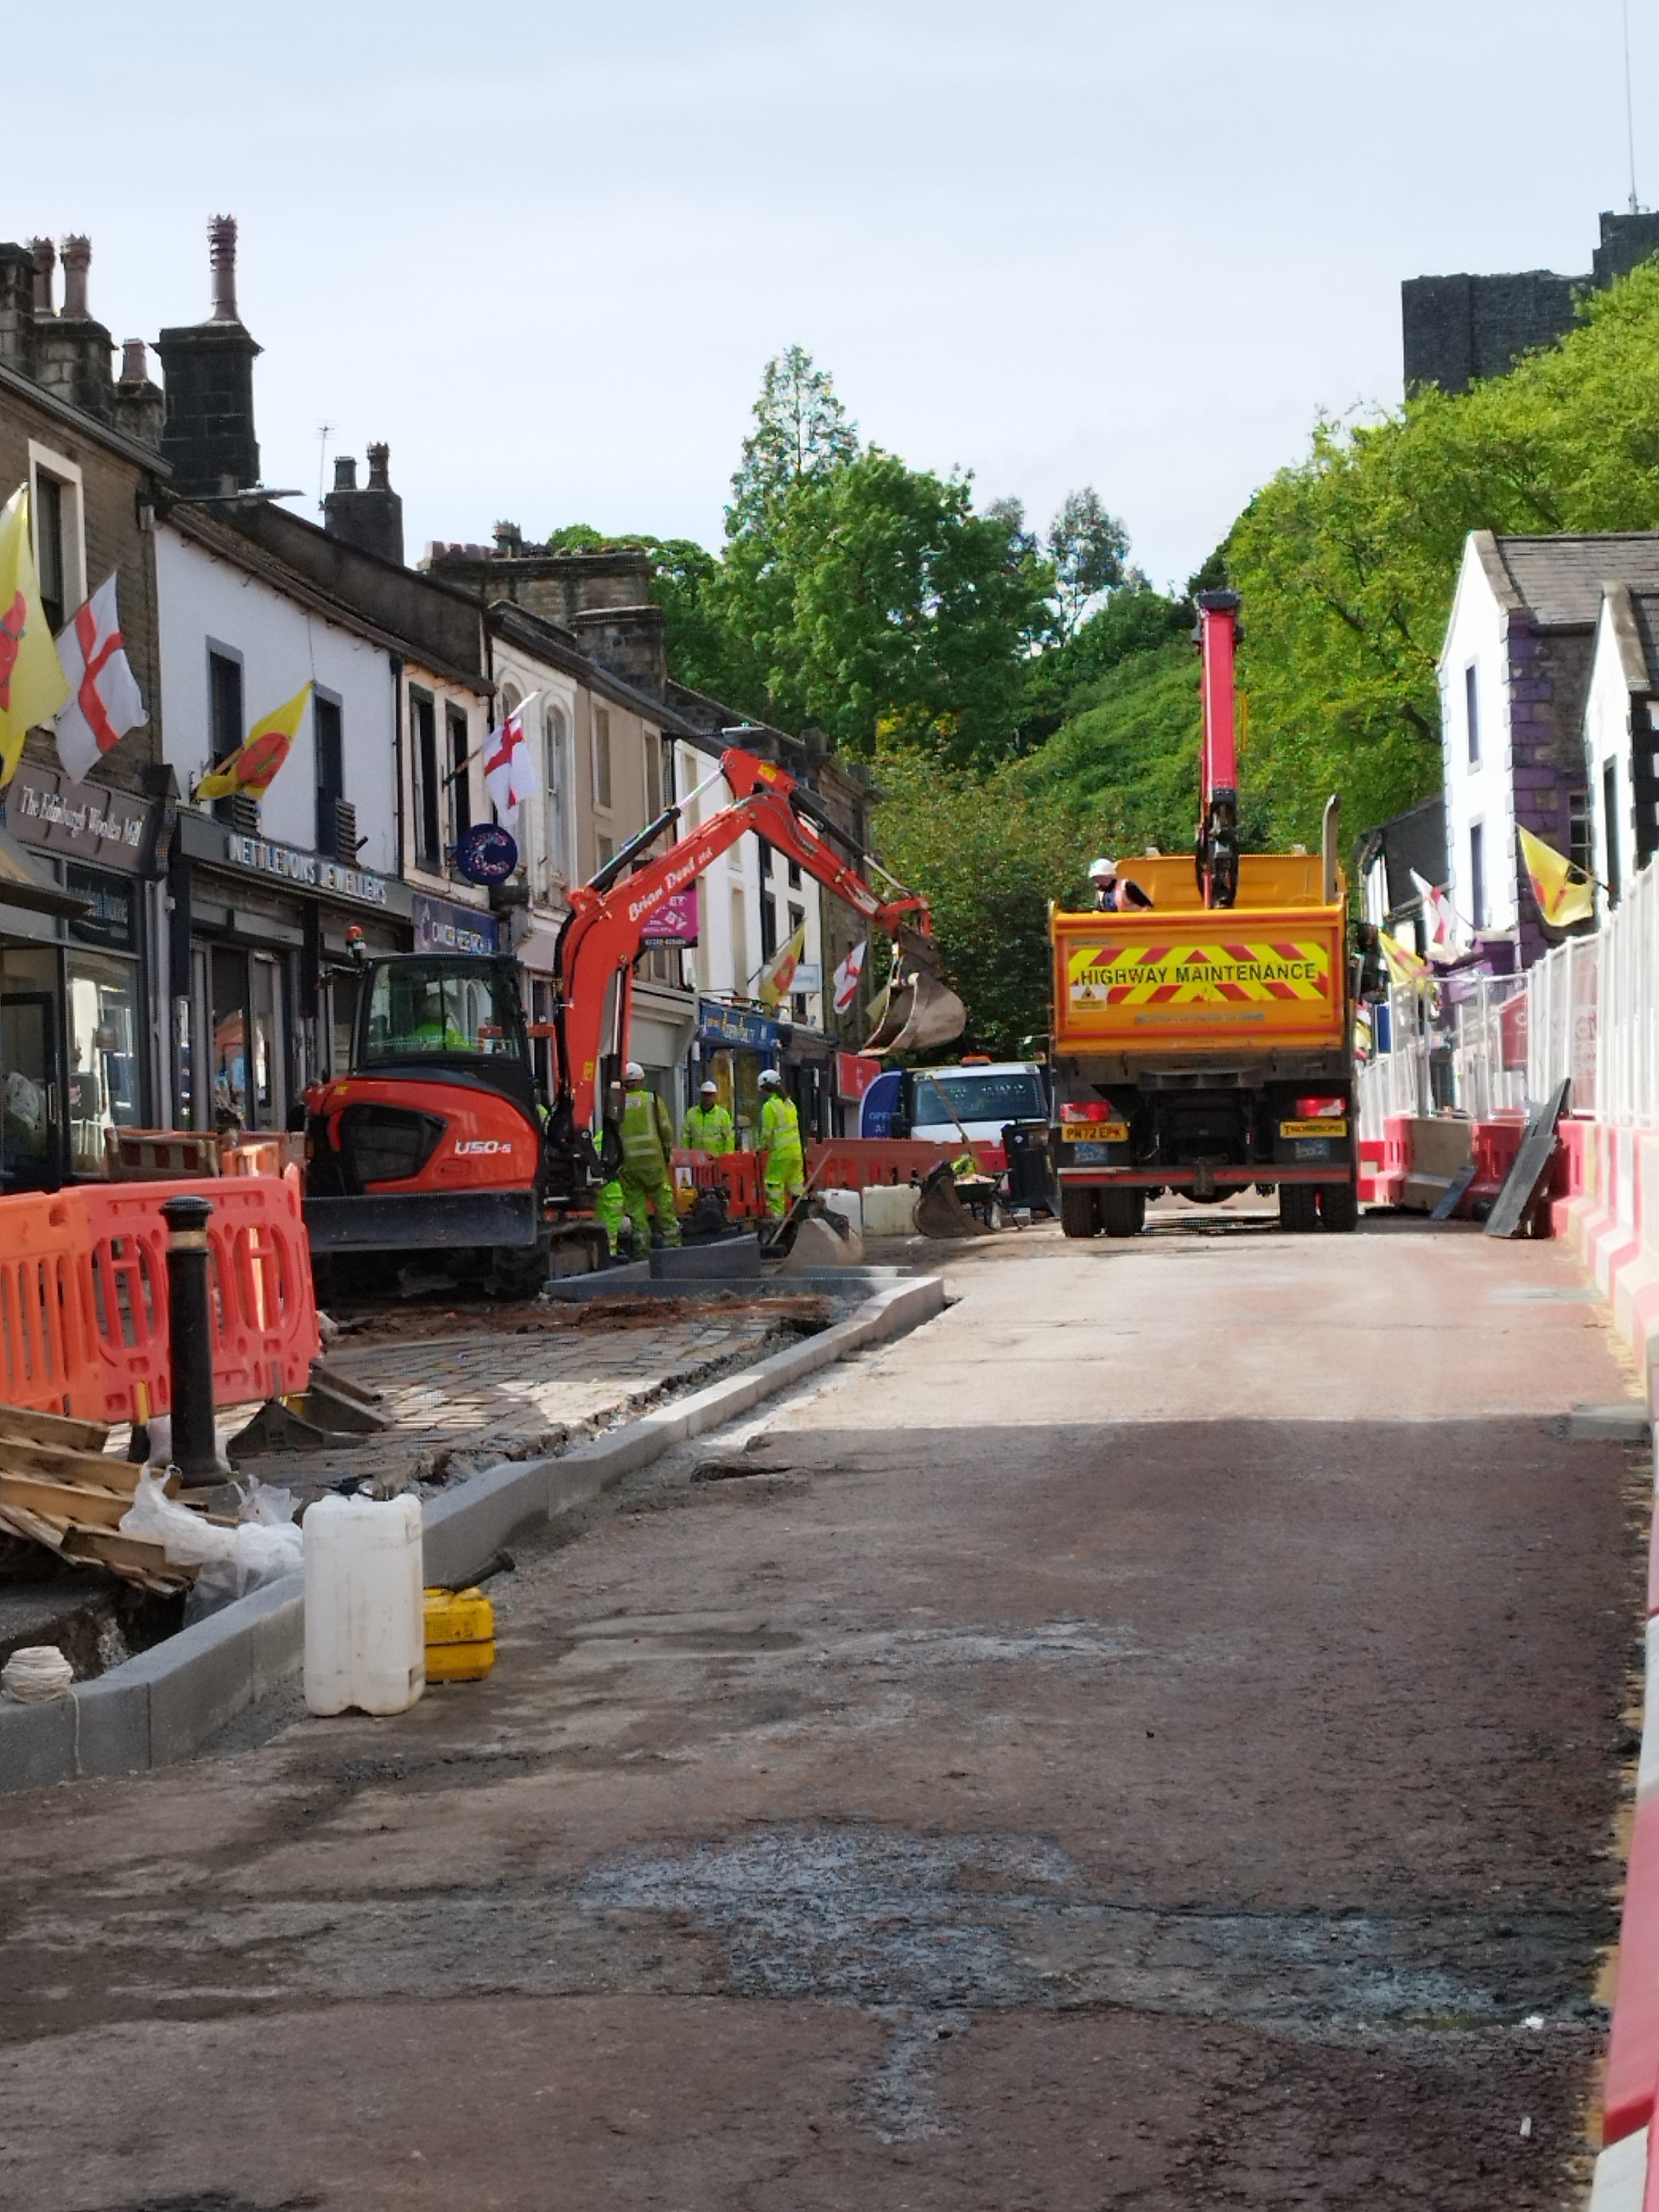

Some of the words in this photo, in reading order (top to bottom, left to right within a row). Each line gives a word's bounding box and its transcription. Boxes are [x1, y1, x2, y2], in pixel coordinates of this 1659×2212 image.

[21, 785, 40, 817] The
[39, 792, 86, 838] Edinburgh
[319, 861, 386, 905] JEWELLERS
[628, 885, 664, 923] Brian
[1080, 967, 1167, 985] HIGHWAY
[1175, 963, 1316, 983] MAINTENANCE
